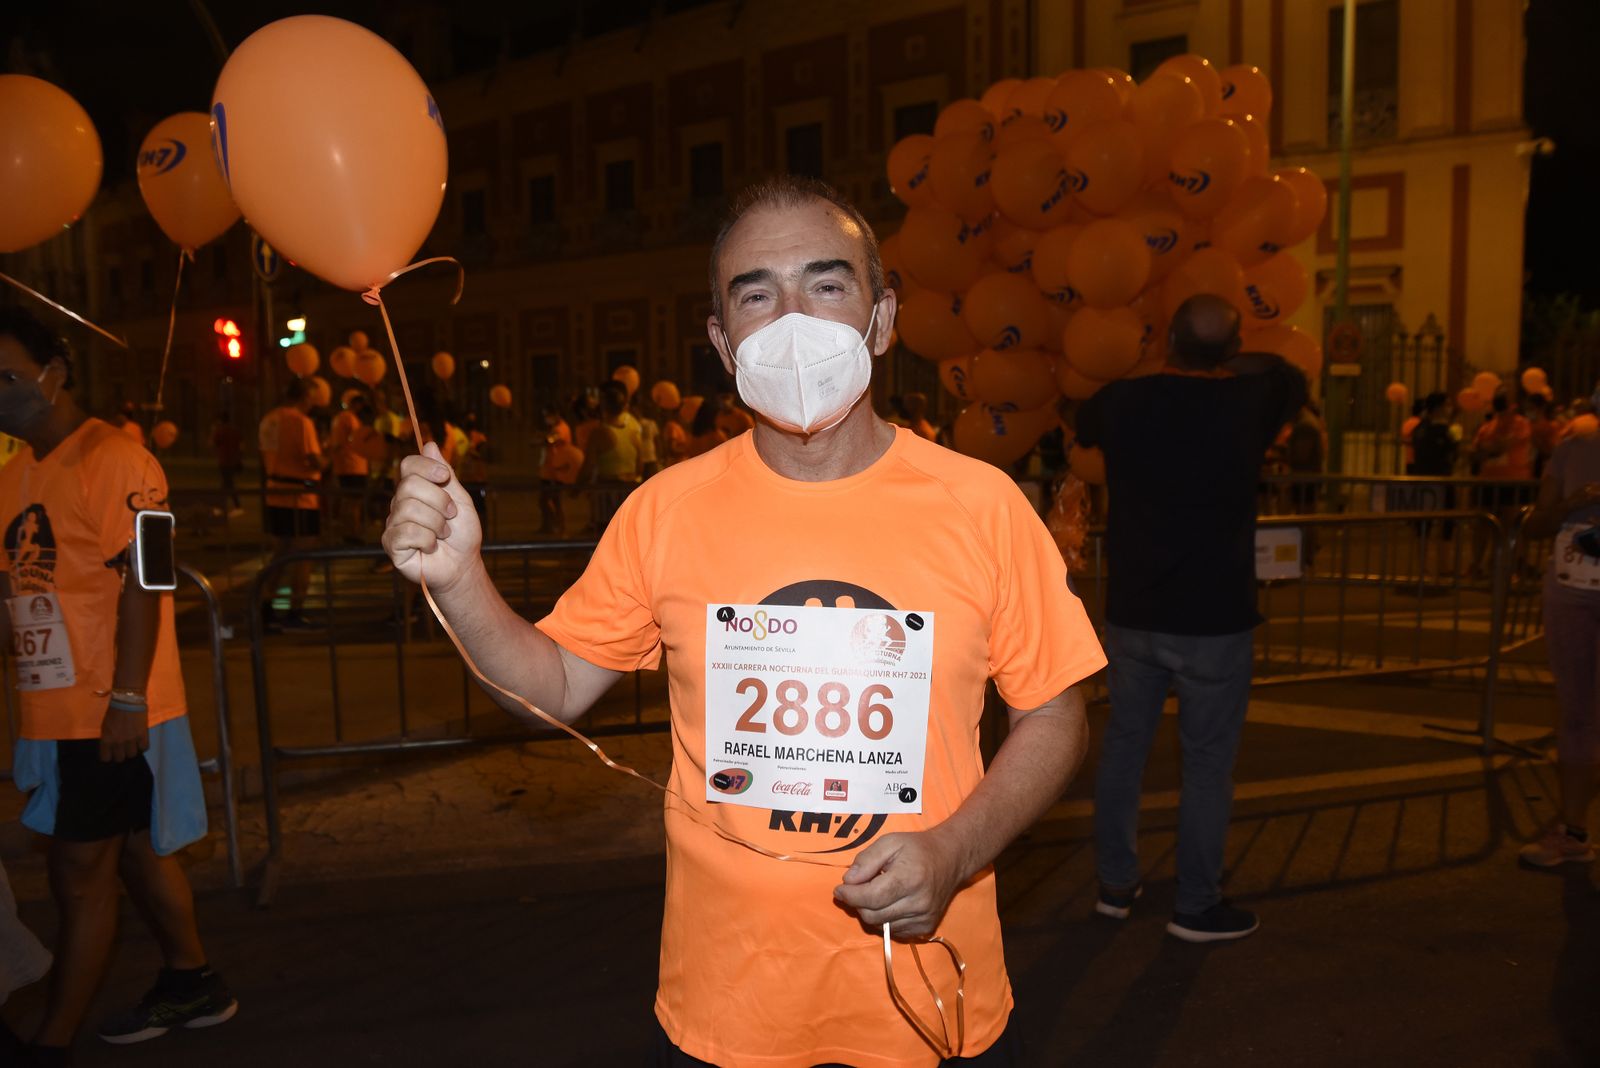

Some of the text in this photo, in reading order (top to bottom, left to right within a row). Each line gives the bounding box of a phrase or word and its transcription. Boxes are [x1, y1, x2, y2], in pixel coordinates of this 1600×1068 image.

[712, 662, 733, 670] XXXIII
[733, 663, 767, 672] CARRERA
[769, 665, 813, 674] NOCTURNA
[892, 670, 908, 679] KH7
[909, 672, 927, 680] 2021
[735, 677, 894, 741] 2886
[724, 741, 903, 765] RAFAEL MARCHENA LANZA
